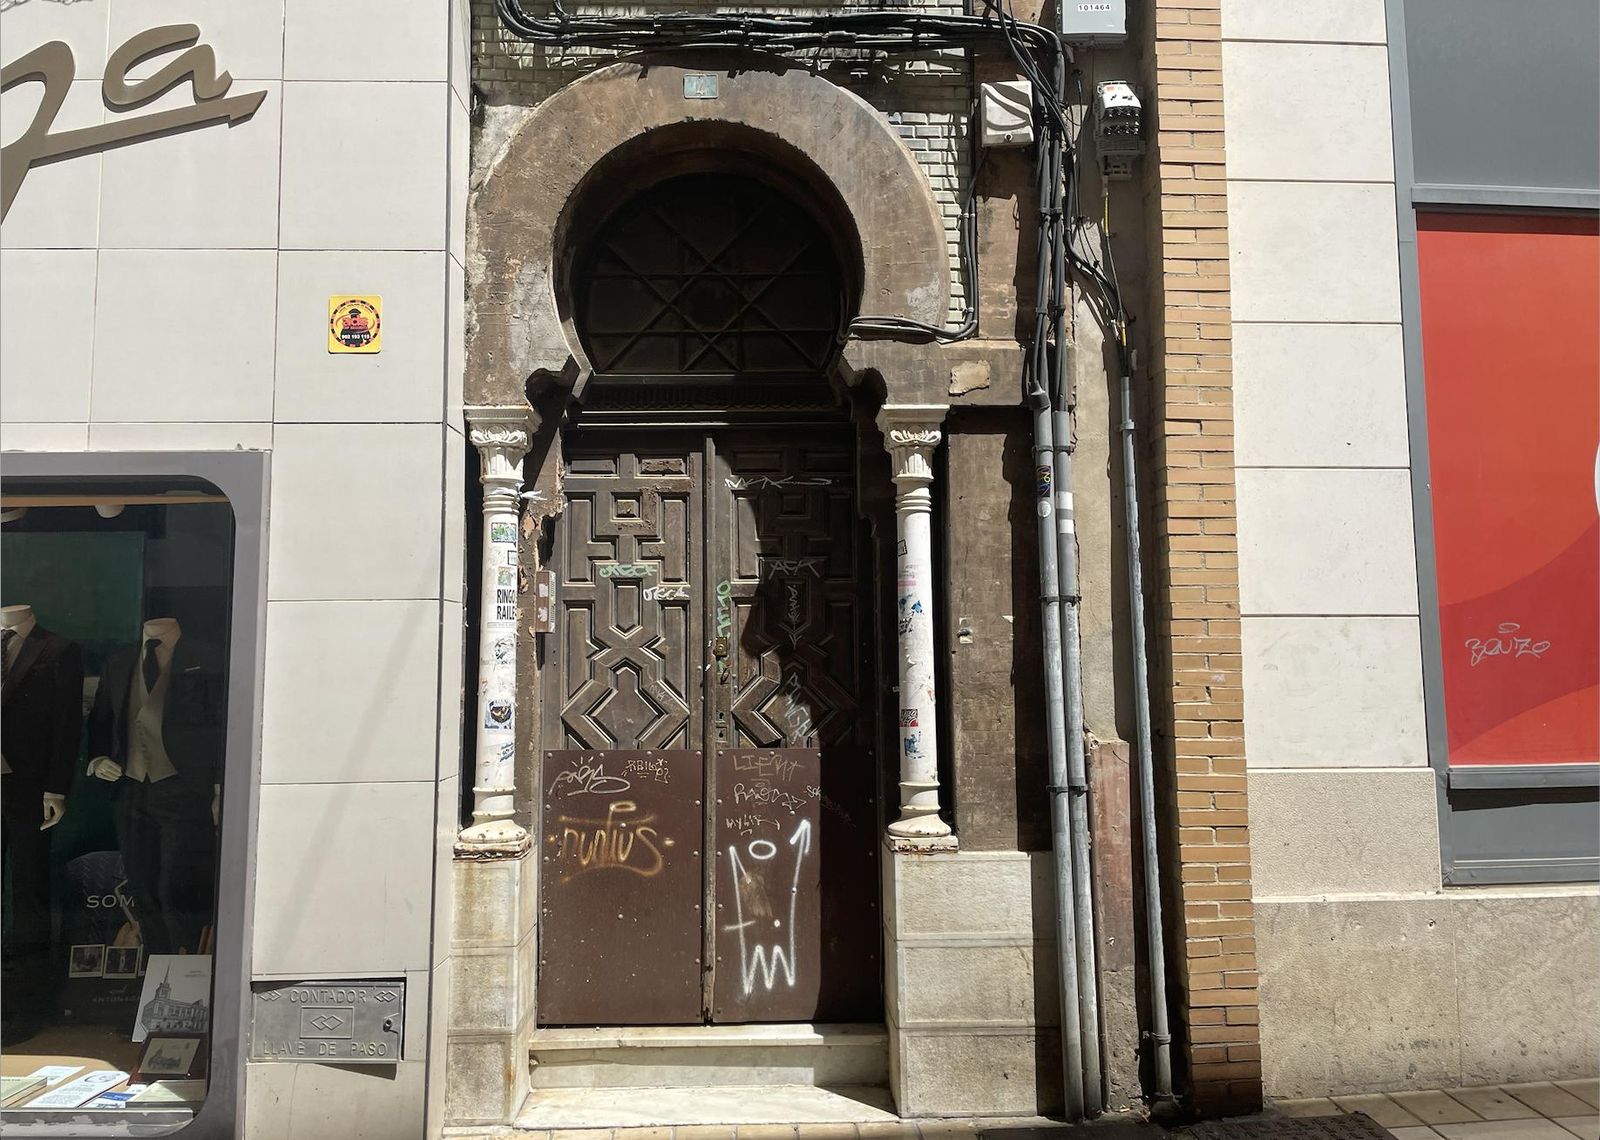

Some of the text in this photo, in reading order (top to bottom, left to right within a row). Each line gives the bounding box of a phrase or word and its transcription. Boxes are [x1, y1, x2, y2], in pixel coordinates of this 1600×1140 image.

[289, 988, 367, 1004] CONTADOR
[263, 1041, 388, 1057] LLAVE DE PASO
